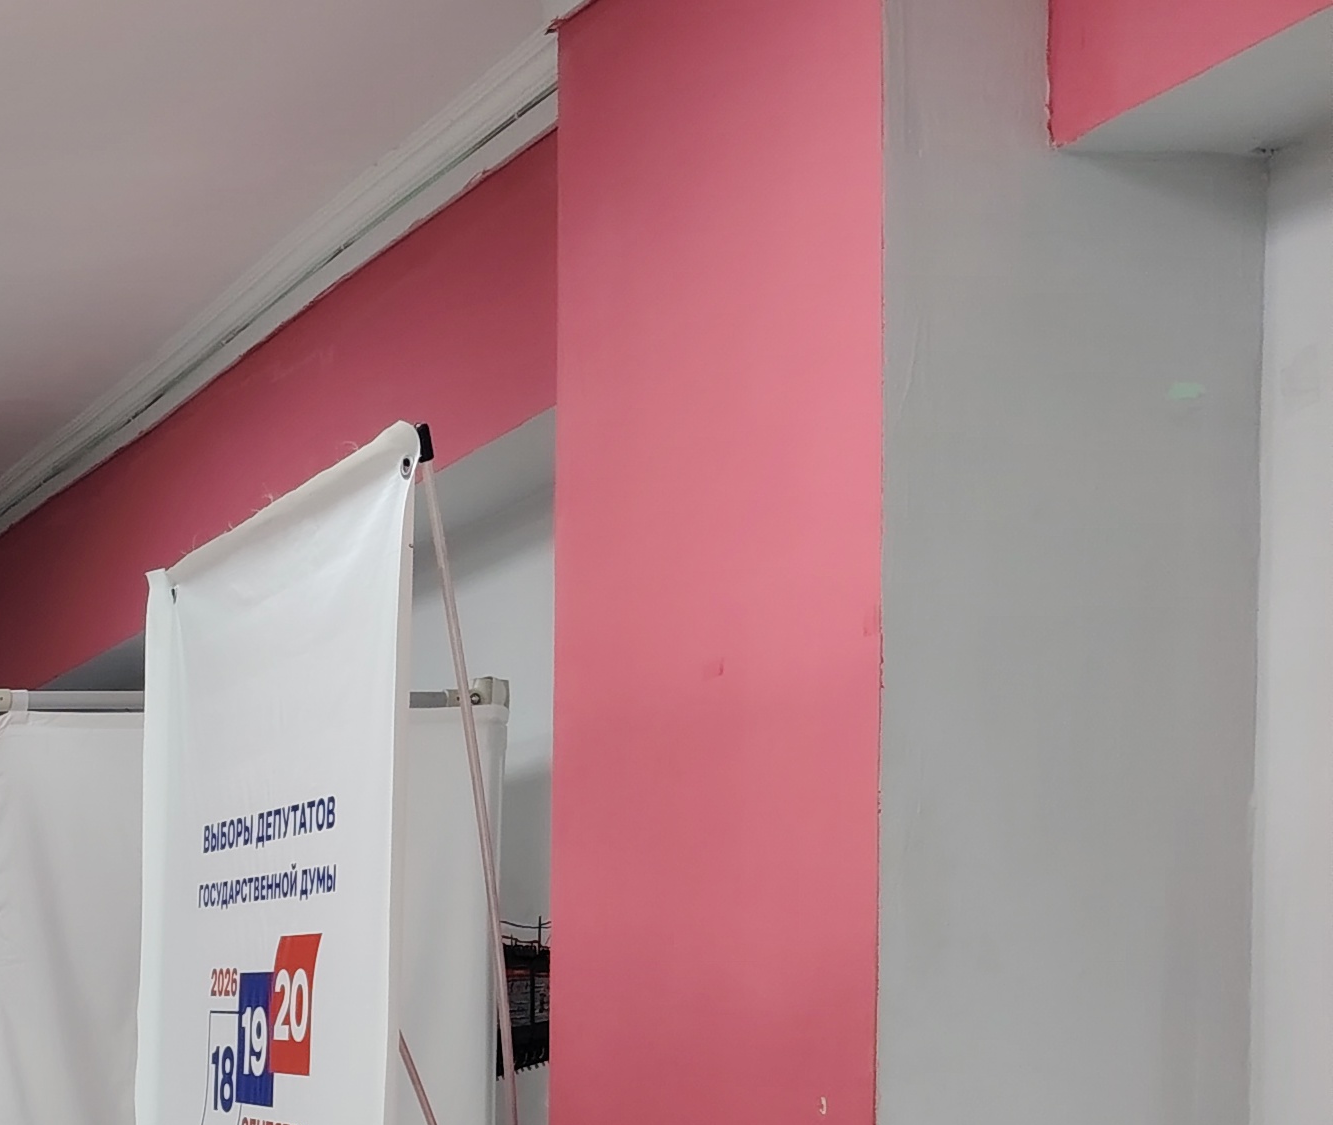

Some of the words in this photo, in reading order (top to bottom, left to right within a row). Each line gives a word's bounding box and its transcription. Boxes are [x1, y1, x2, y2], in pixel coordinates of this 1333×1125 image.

[202, 814, 254, 854] ВЫБОРЫ
[255, 796, 336, 849] ДЕПУТАТОВ
[198, 863, 298, 909] ГОСУДАРСТВЕННОЙ
[299, 864, 337, 901] ДУМЫ
[210, 968, 238, 997] 2026
[211, 1046, 235, 1113] 18
[241, 1006, 268, 1077] 19
[273, 968, 309, 1043] 20
